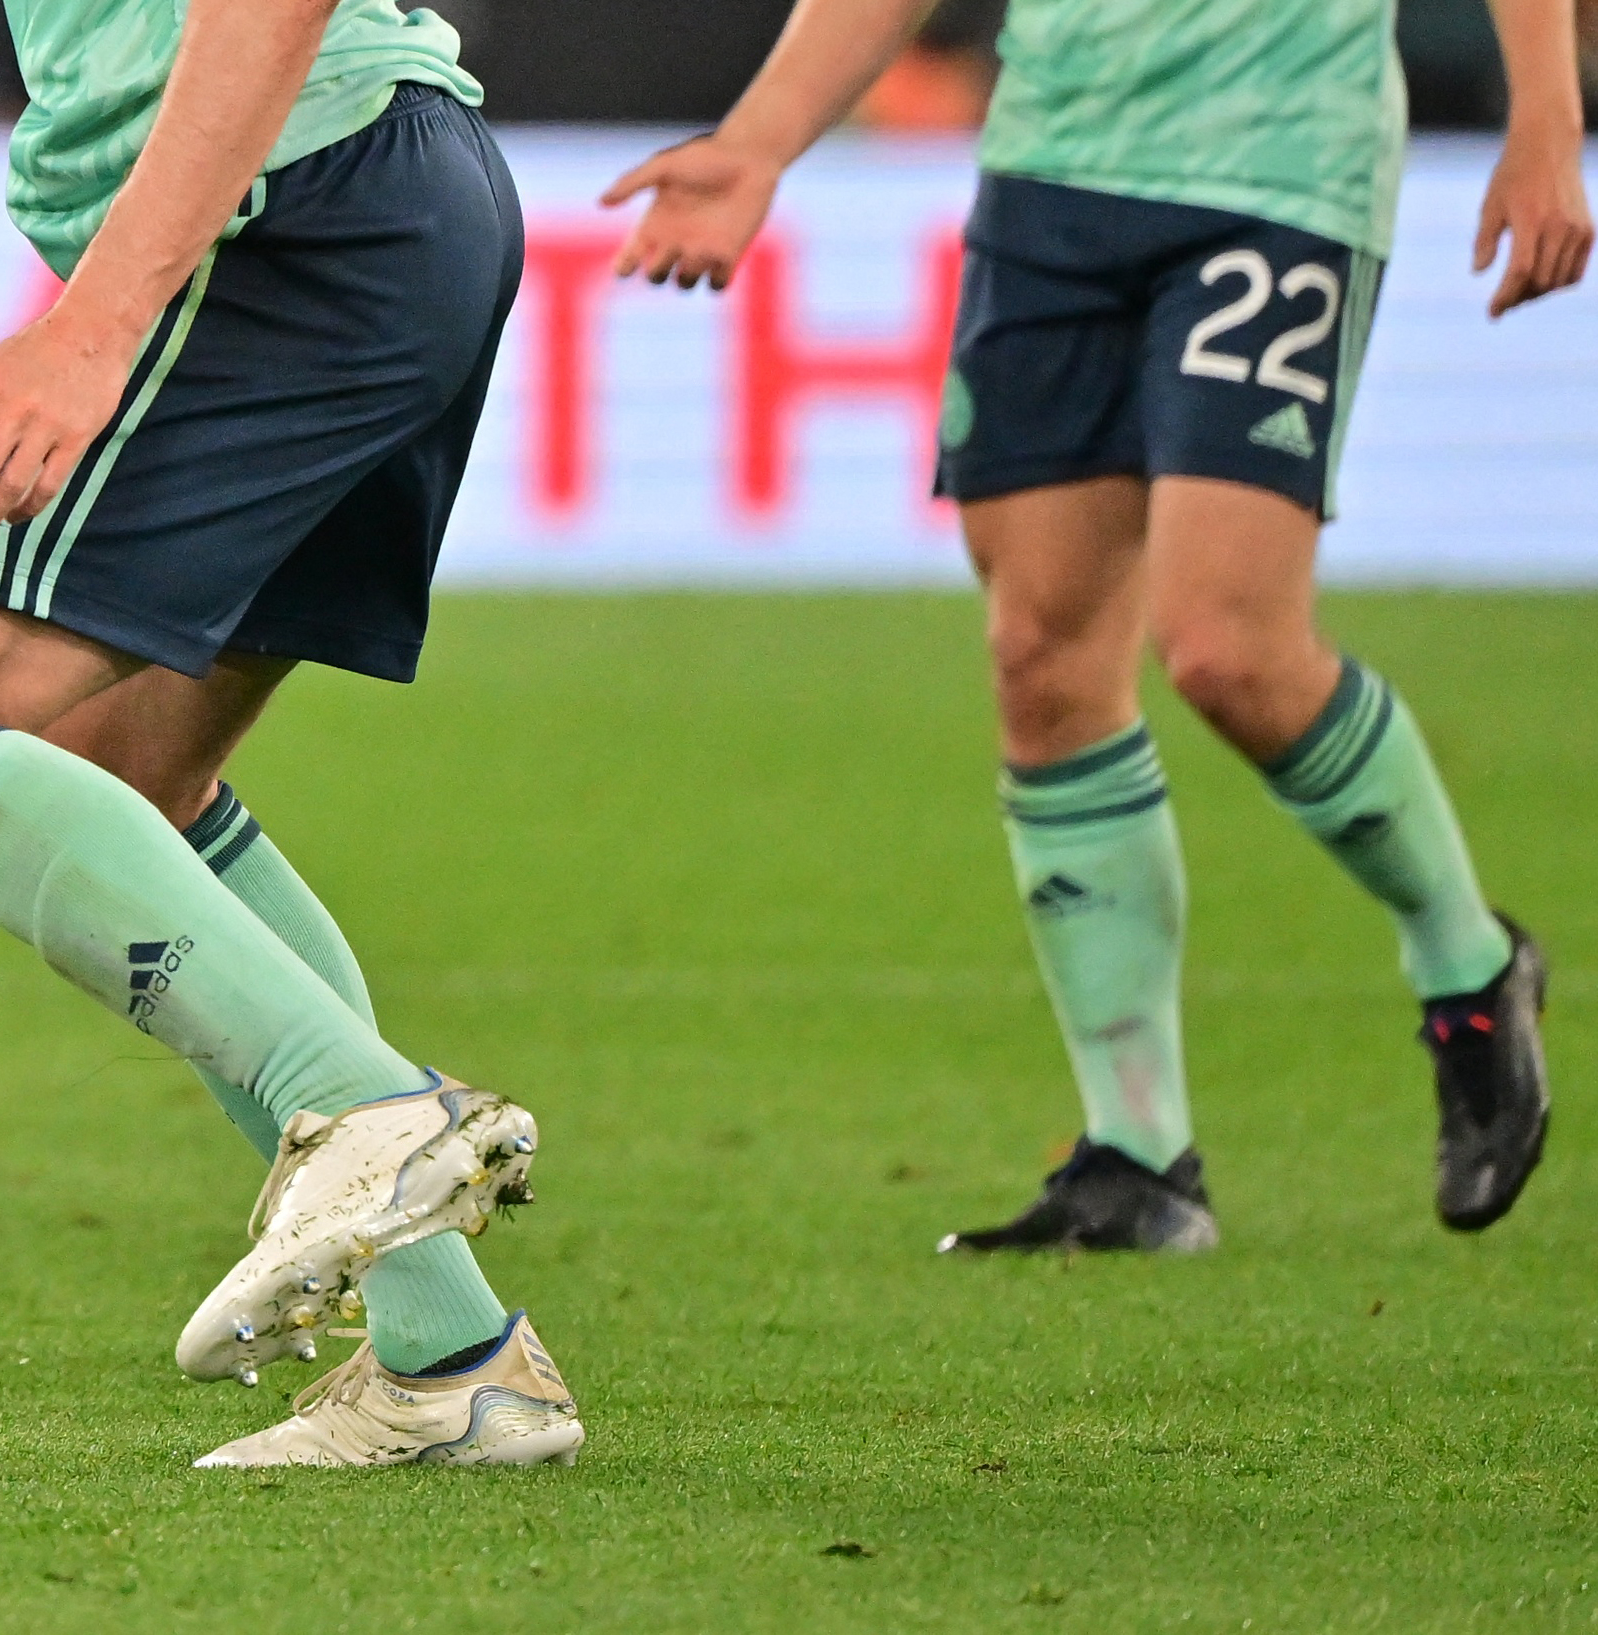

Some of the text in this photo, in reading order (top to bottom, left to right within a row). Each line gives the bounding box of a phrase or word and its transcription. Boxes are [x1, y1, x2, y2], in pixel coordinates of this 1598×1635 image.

[1179, 247, 1341, 406] 22
[135, 934, 195, 1036] adidas
[382, 1382, 416, 1404] COPA
